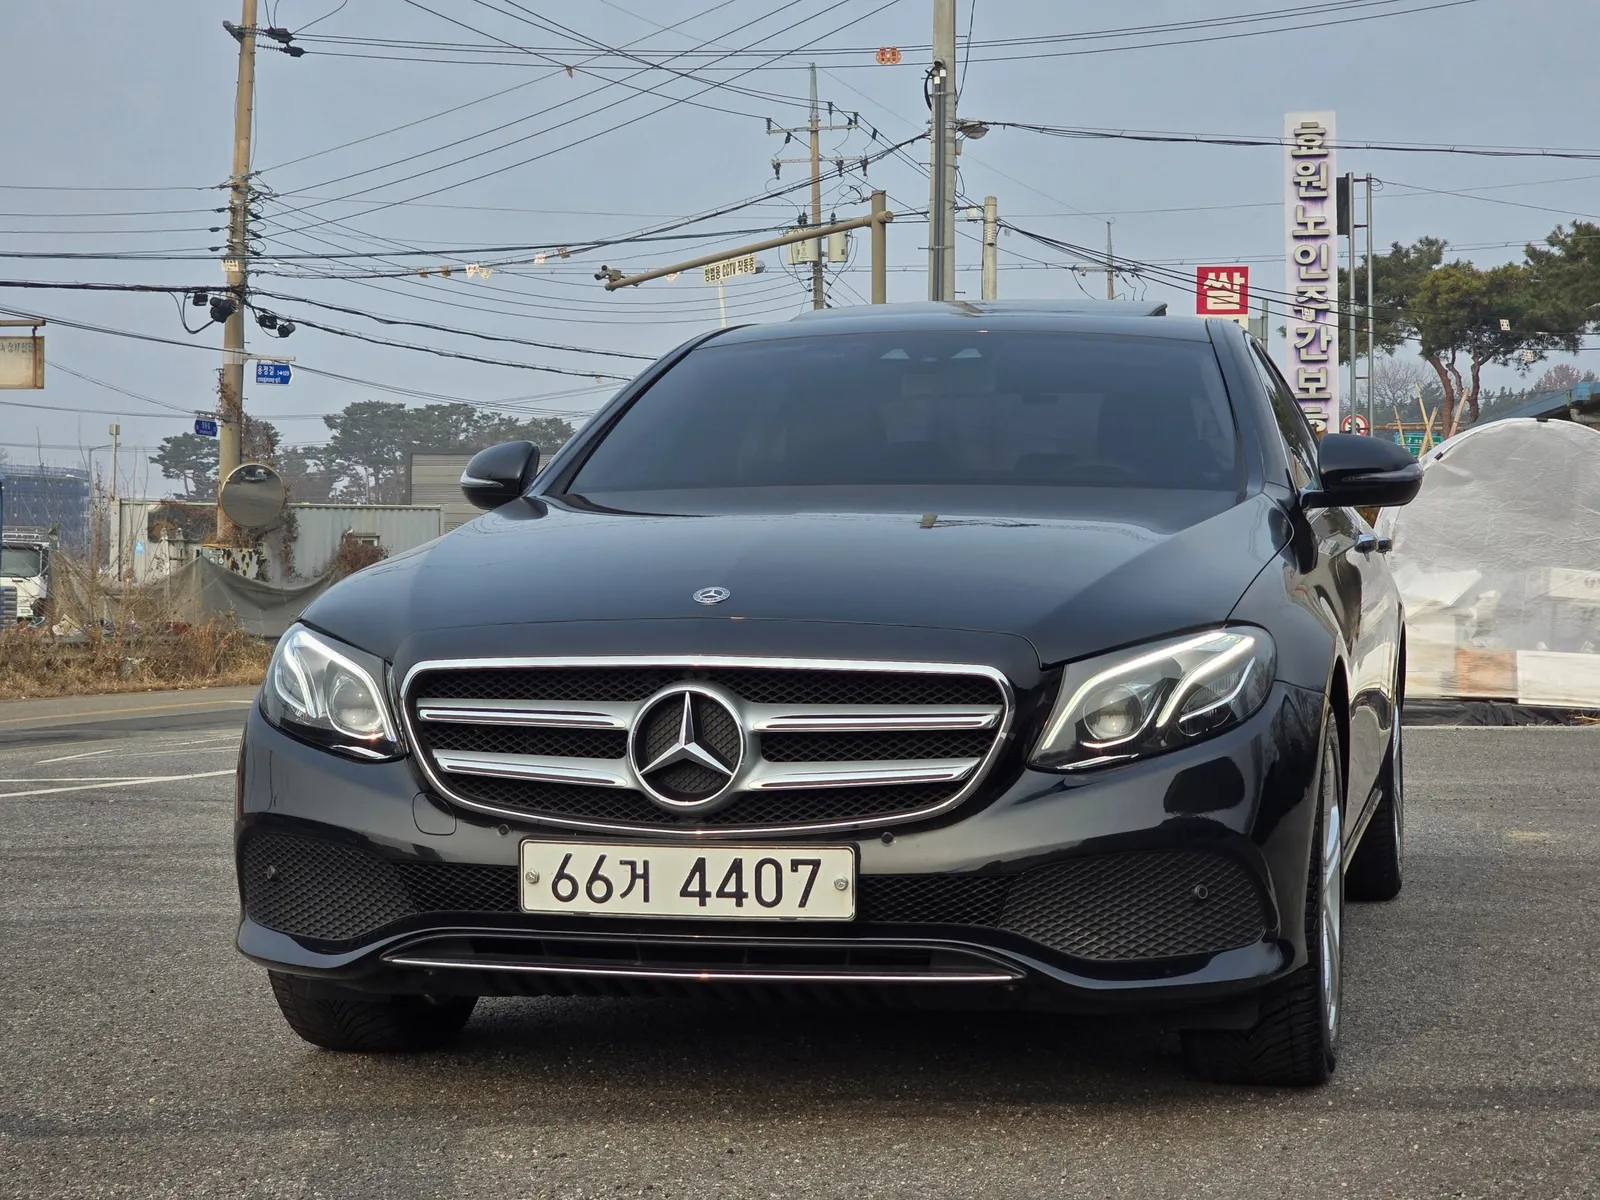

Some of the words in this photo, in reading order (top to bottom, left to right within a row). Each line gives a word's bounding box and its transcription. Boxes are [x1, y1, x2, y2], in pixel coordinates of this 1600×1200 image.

[704, 265, 721, 282] 방범용
[722, 261, 737, 278] CCTV
[737, 257, 754, 273] 작동중
[1203, 272, 1245, 310] 쌀
[551, 852, 651, 904] 66거
[679, 856, 822, 908] 4407
